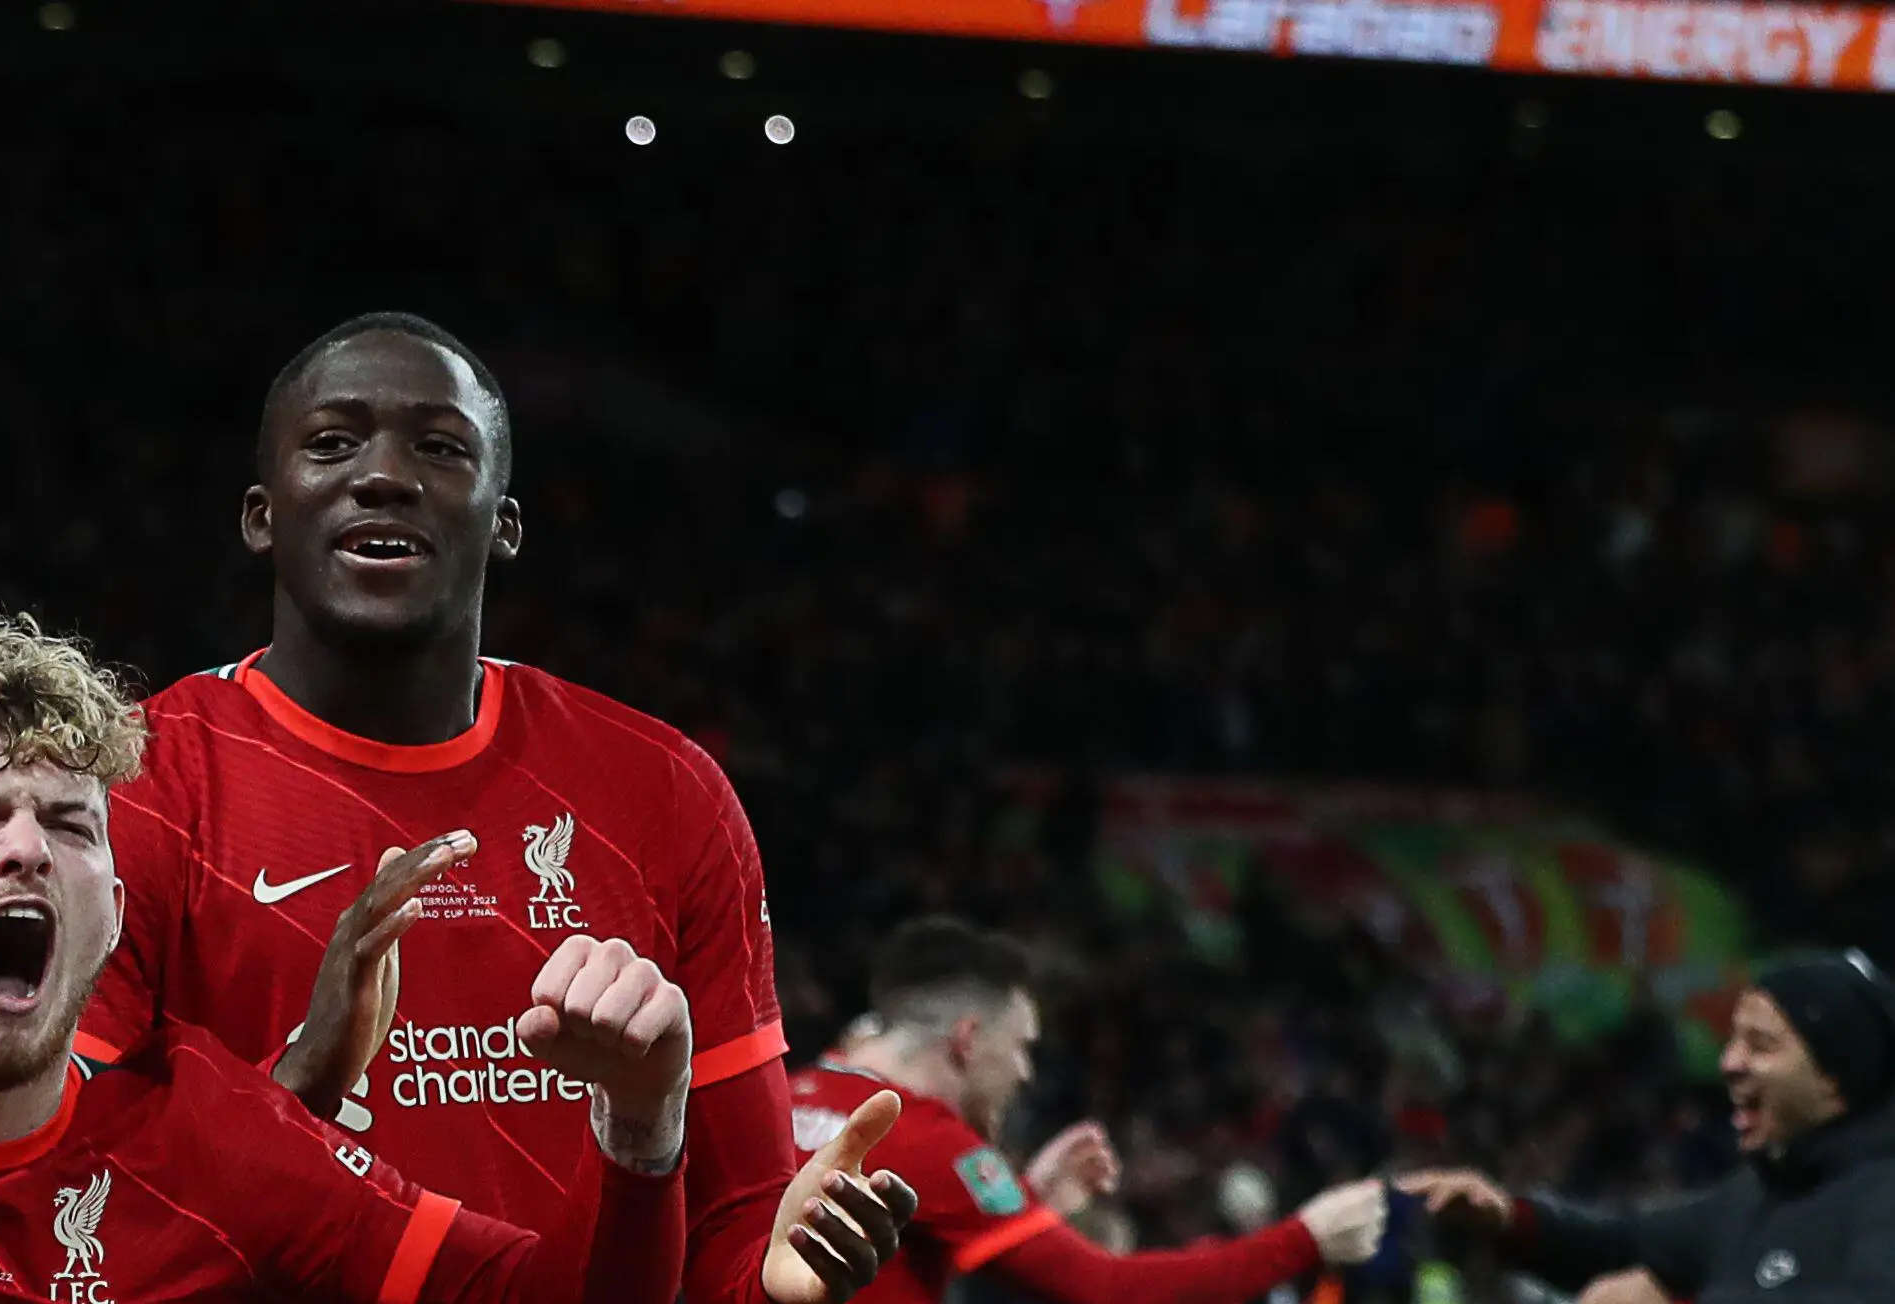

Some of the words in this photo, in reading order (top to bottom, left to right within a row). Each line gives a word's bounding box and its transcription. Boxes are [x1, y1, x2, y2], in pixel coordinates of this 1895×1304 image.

[1537, 0, 1846, 87] ENERGY
[444, 910, 465, 919] CUP
[468, 908, 498, 918] FINAL
[472, 896, 498, 905] 2022
[527, 904, 589, 929] L.F.C.
[389, 1016, 533, 1064] stand
[393, 1062, 593, 1108] chartere
